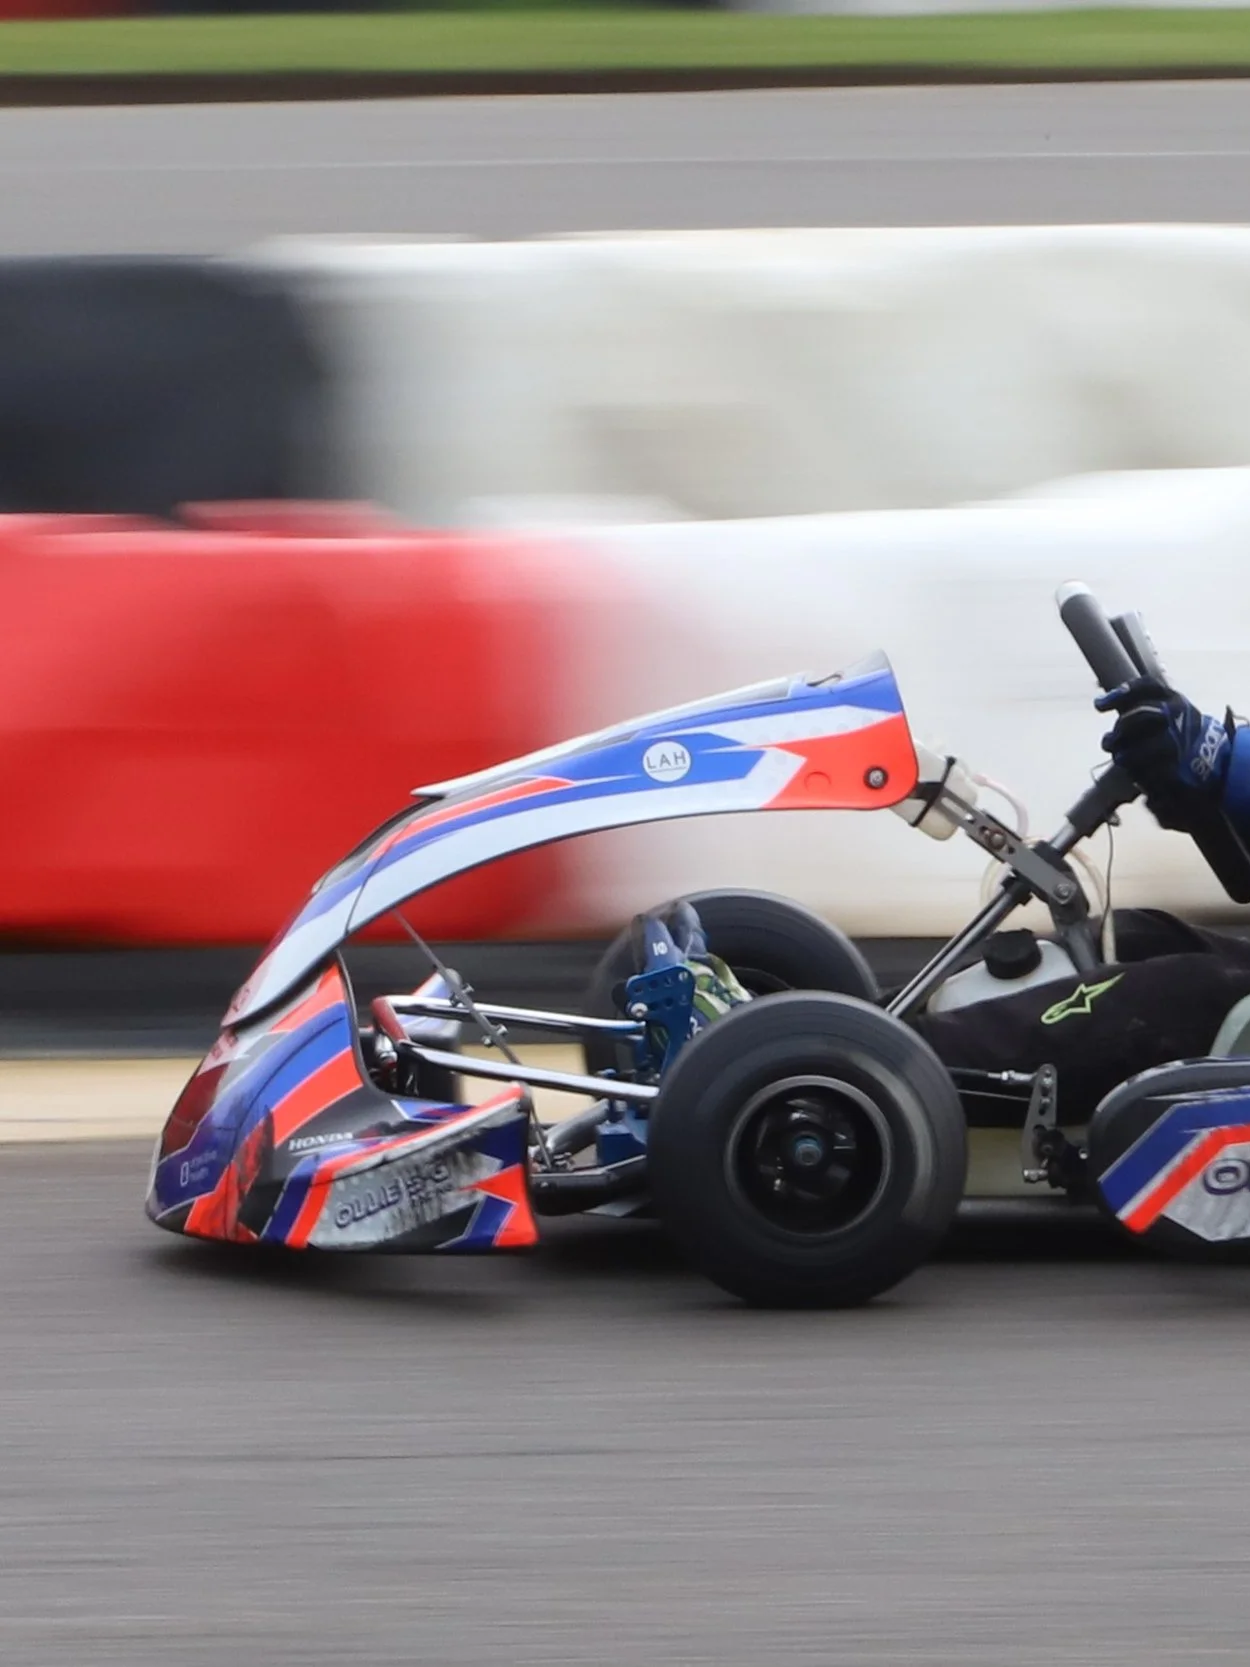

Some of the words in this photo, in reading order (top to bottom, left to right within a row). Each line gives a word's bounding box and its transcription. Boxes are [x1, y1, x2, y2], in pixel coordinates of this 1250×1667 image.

[646, 750, 687, 769] LAH
[288, 1132, 355, 1151] HONDA
[334, 1180, 402, 1230] OLLIE
